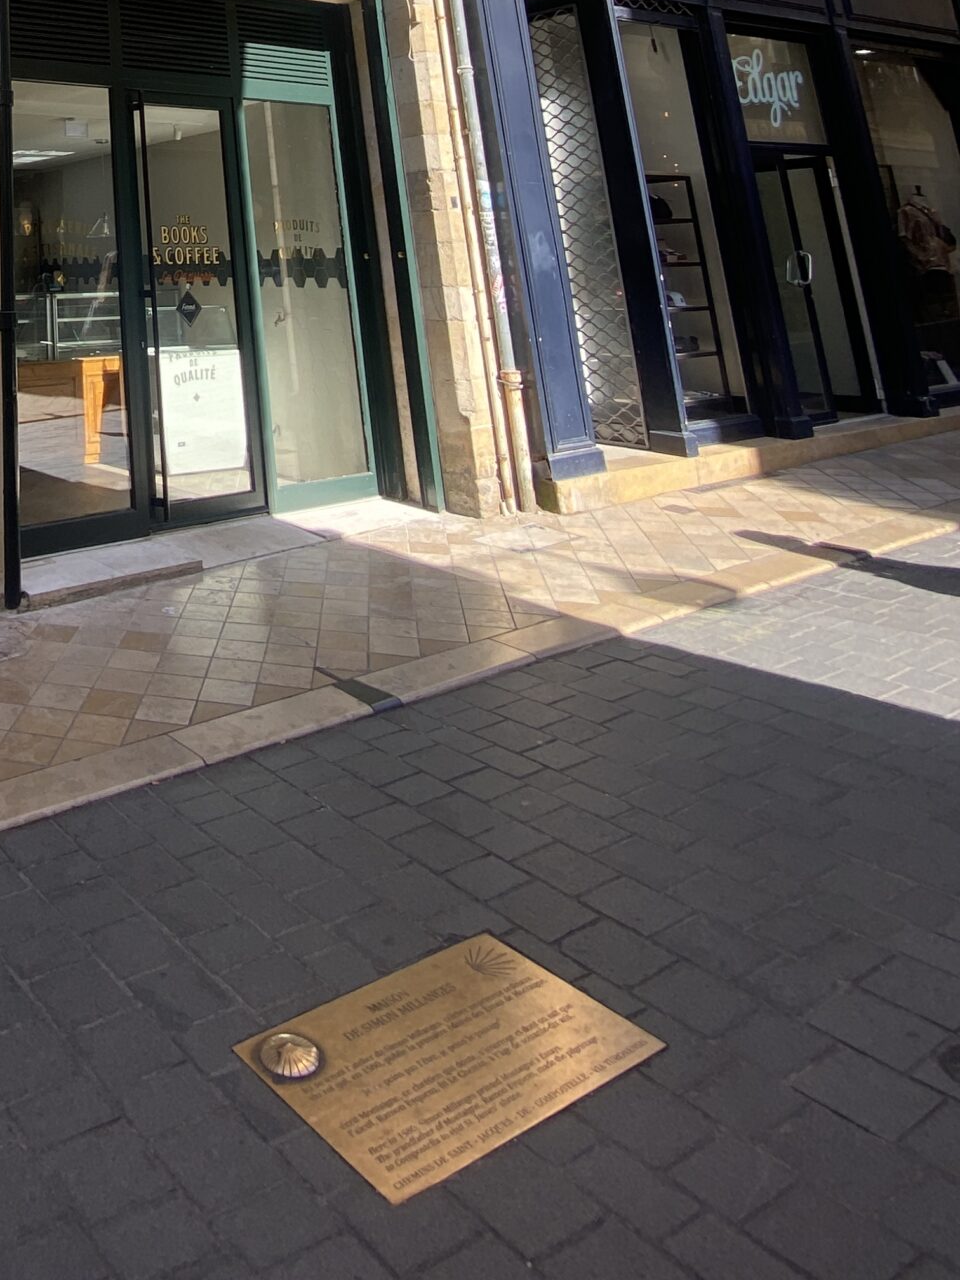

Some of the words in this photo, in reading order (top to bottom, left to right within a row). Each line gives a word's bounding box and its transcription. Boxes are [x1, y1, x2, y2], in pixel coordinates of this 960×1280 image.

[732, 49, 803, 128] Edgar
[176, 215, 190, 225] THE
[160, 226, 209, 244] BOOKS
[165, 247, 220, 265] COFFEE
[189, 358, 198, 367] DE
[174, 364, 216, 386] QUALITÉ
[358, 1009, 400, 1033] SIMON
